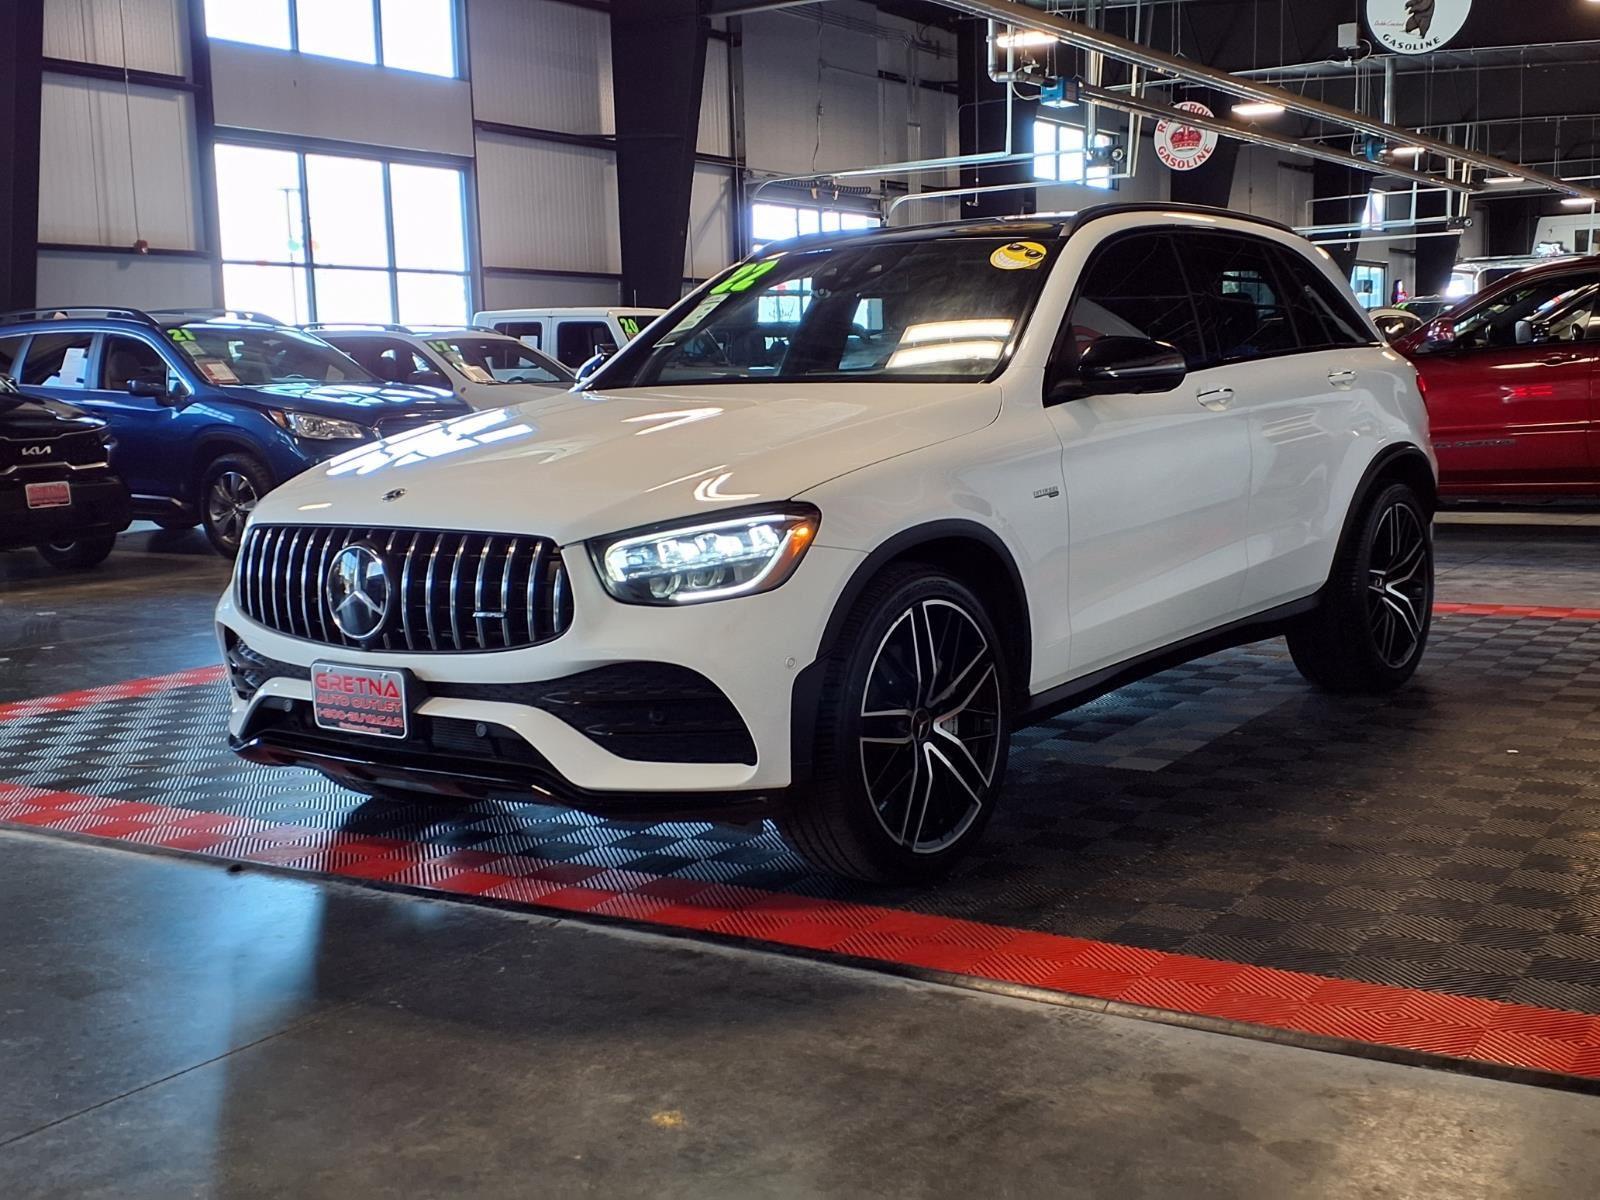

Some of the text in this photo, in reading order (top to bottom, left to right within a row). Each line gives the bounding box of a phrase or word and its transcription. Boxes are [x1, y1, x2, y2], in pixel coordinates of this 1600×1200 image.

[1382, 33, 1441, 51] GASOLINE
[1180, 103, 1211, 117] CRO
[1158, 144, 1213, 169] GASOLINE
[166, 328, 196, 341] 21
[619, 318, 639, 334] 20
[315, 672, 400, 698] GRETNA
[316, 693, 402, 713] AUTO OUTLET
